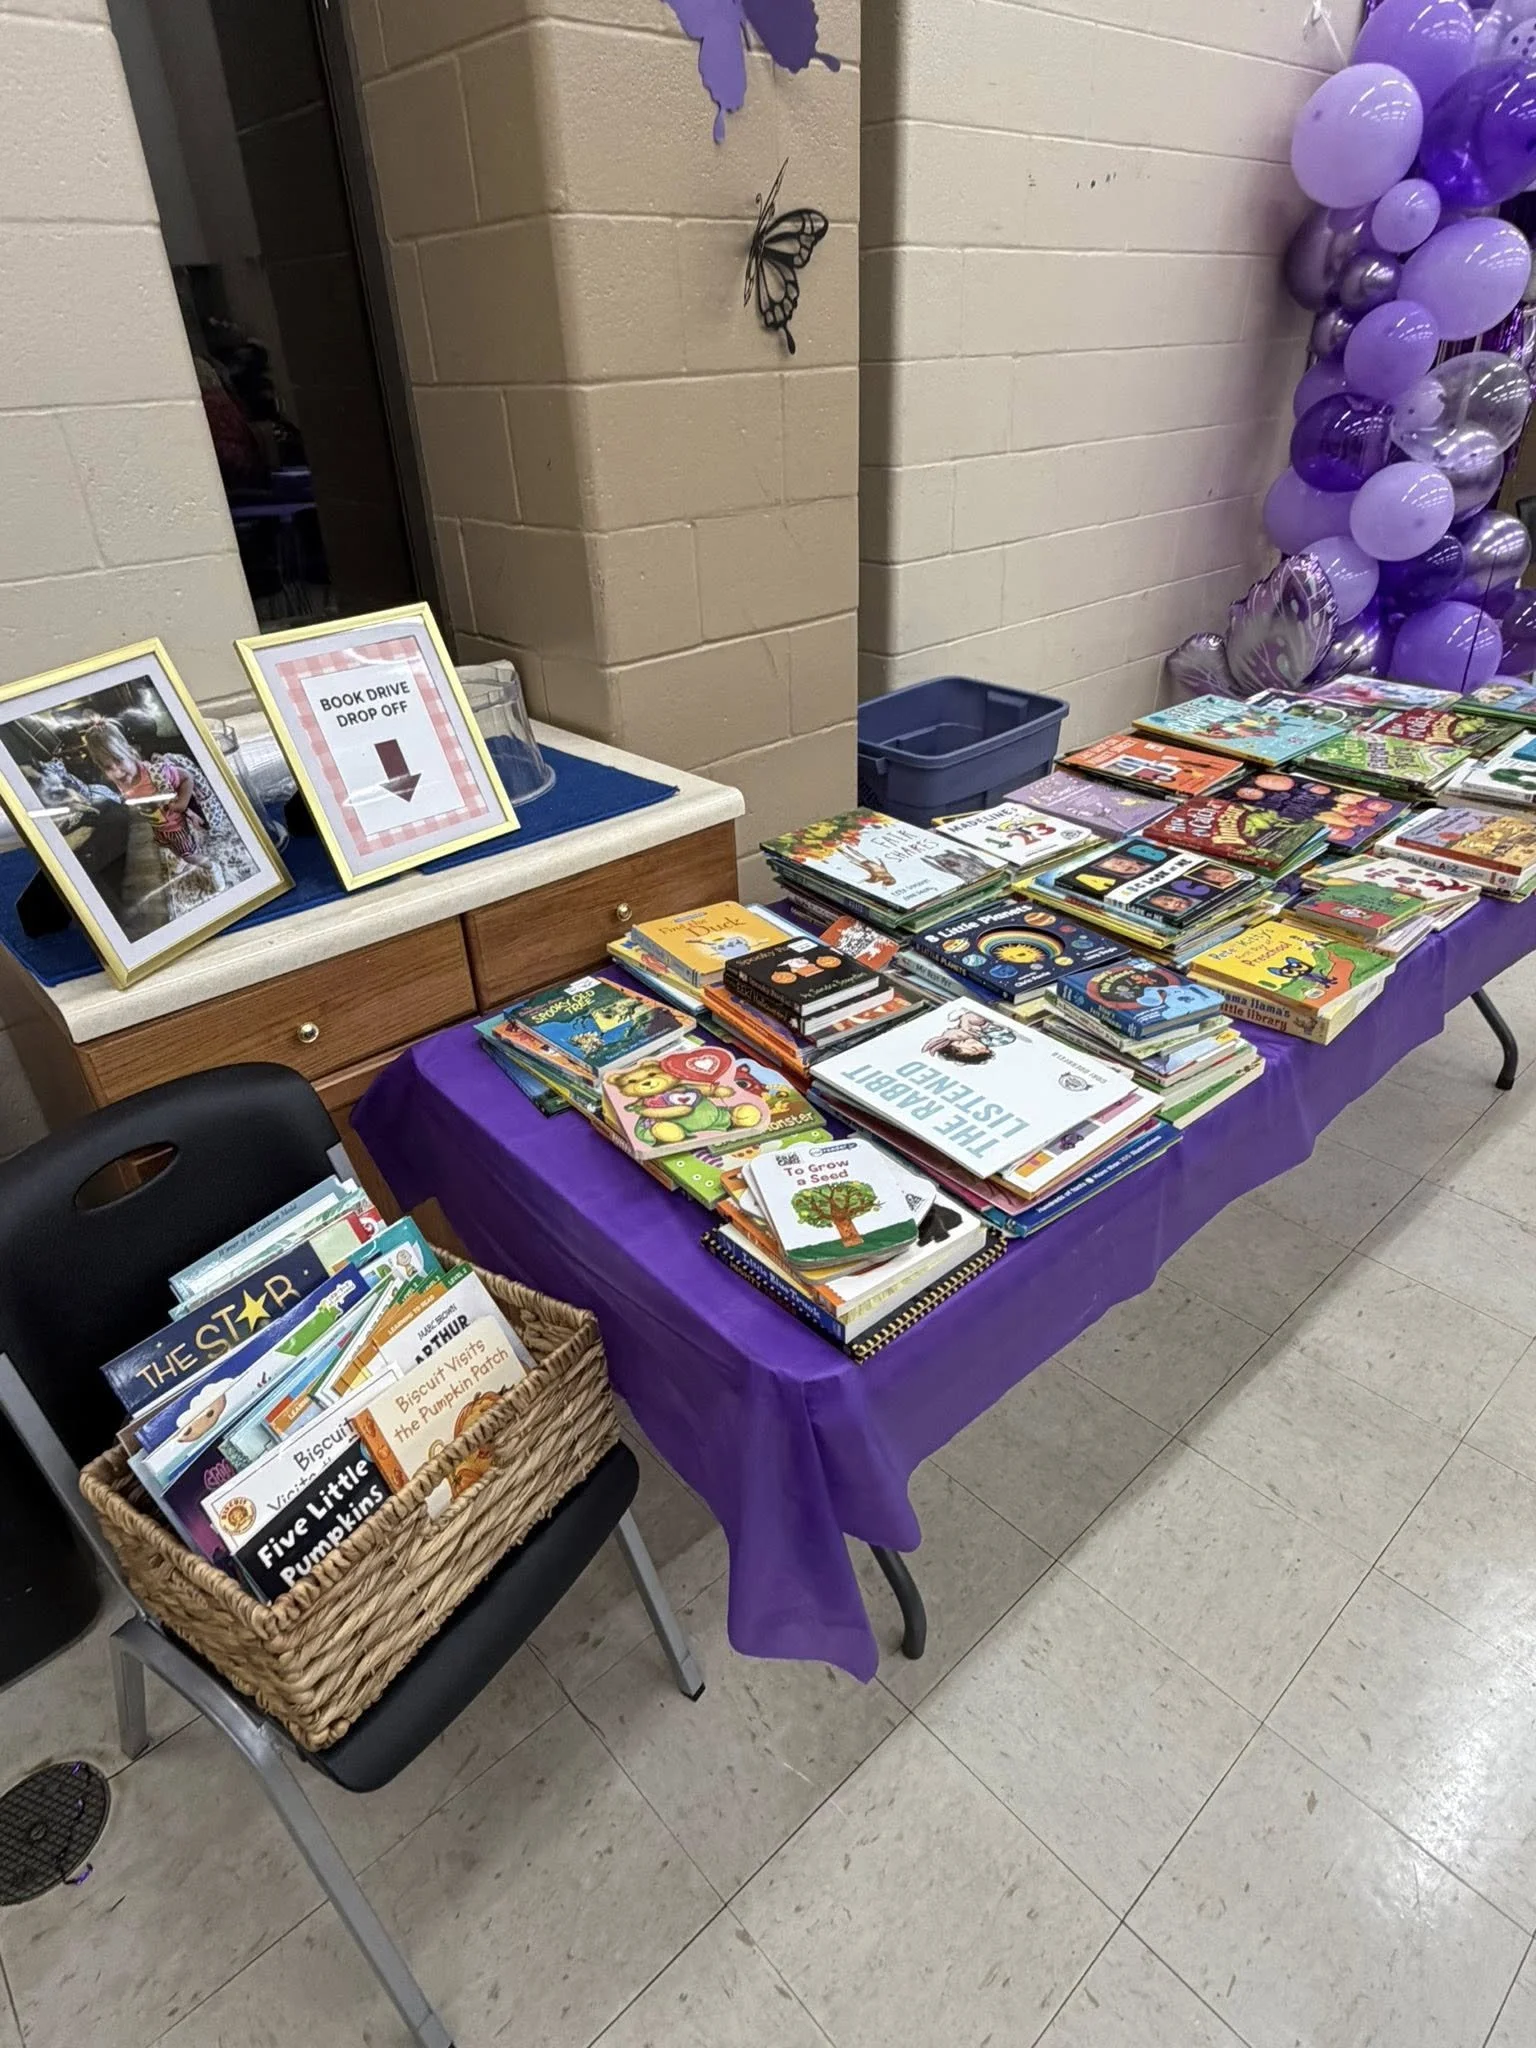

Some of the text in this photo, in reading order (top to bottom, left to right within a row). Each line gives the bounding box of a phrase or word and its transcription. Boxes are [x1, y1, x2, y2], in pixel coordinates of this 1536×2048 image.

[320, 681, 410, 711] BOOK DRIVE
[336, 701, 409, 727] DROP OFF
[948, 807, 1018, 833] MADELINE'S
[871, 829, 919, 850] FAIR
[885, 840, 940, 863] SHARES
[686, 916, 747, 937] Duck
[924, 904, 1033, 943] 8 Little Planets
[1241, 940, 1292, 966] Preschool
[531, 999, 571, 1024] SPOOKY
[571, 989, 596, 1002] OLD
[564, 999, 596, 1015] TREE
[1247, 1008, 1288, 1031] library
[1251, 998, 1290, 1018] llama's
[840, 1064, 1000, 1159] THE RABBIT
[896, 1061, 1031, 1138] LISTENED
[784, 1166, 805, 1177] To
[808, 1158, 850, 1173] Grow
[796, 1169, 849, 1186] a Seed
[741, 1252, 768, 1277] Little
[387, 1294, 435, 1335] LEARNING TO READ
[417, 1302, 458, 1341] MARC BROWN
[136, 1343, 198, 1389] THE
[395, 1338, 486, 1414] Biscuit Visits
[393, 1348, 509, 1443] the Pumpkin Patch
[294, 1416, 355, 1471] Biscuit
[221, 1499, 247, 1520] BISCUIT
[257, 1459, 370, 1569] Five Little
[279, 1484, 384, 1589] Pumpkins
